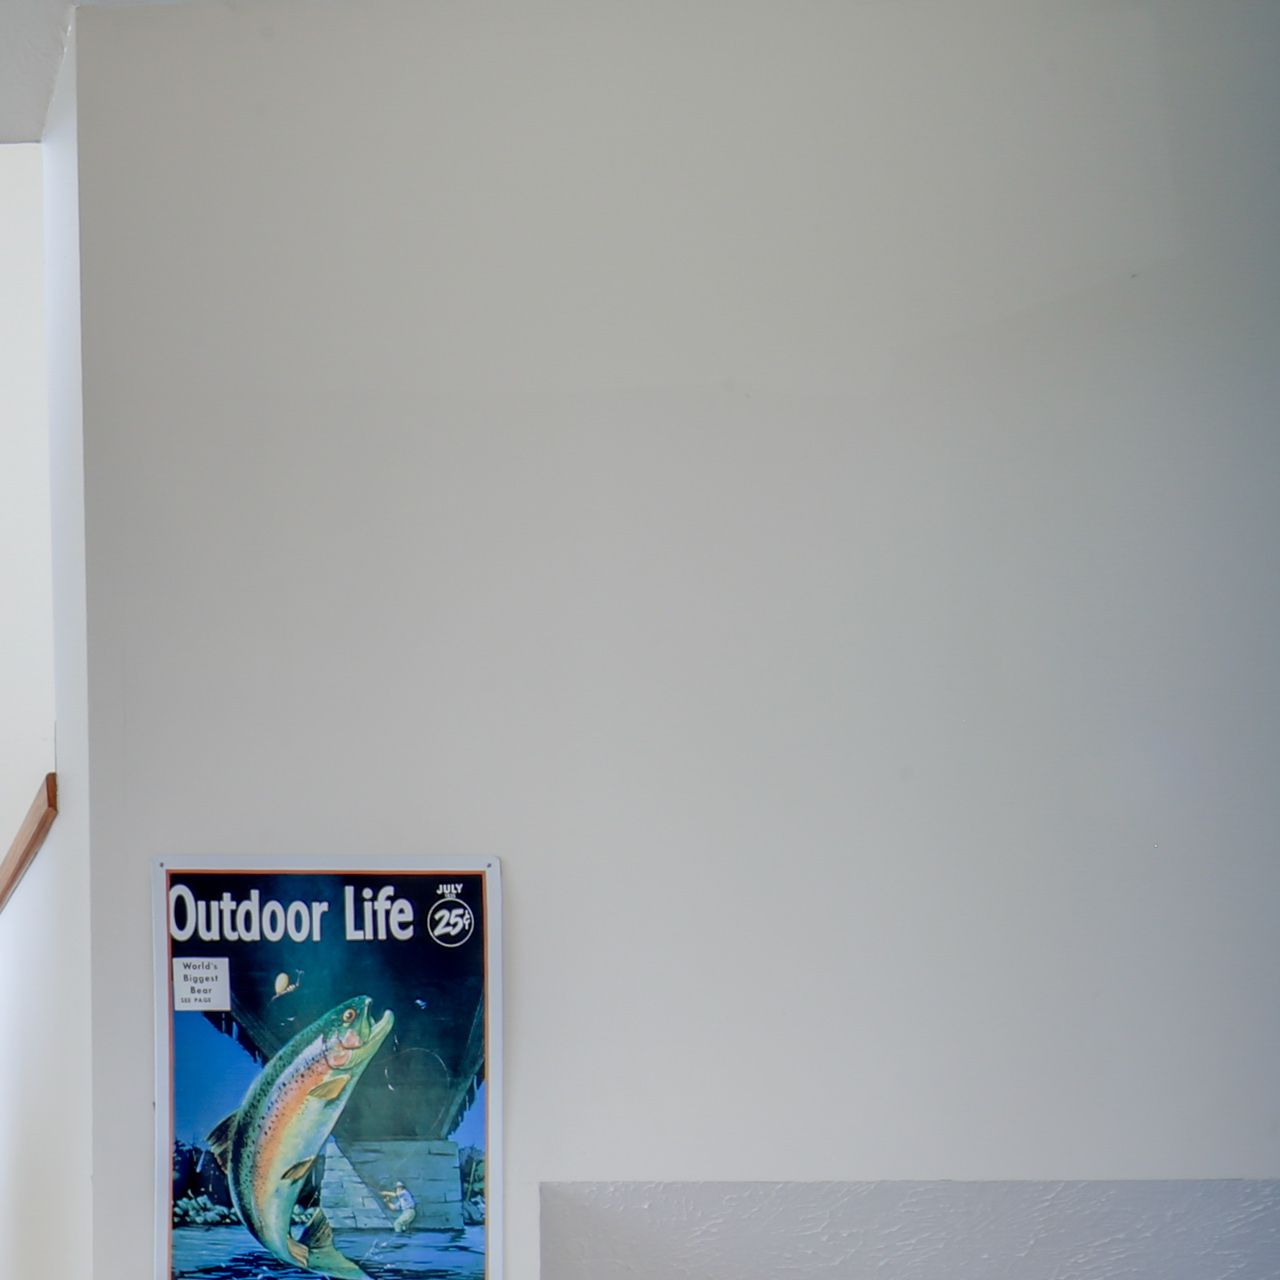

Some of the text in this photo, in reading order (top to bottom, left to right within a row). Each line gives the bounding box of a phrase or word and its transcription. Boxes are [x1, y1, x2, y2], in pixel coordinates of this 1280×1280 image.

[436, 883, 463, 894] JULY
[169, 884, 414, 942] Outdoor Life
[433, 908, 471, 936] 25¢
[183, 961, 218, 970] World's
[183, 974, 218, 984] Biggest
[190, 986, 212, 994] Bear
